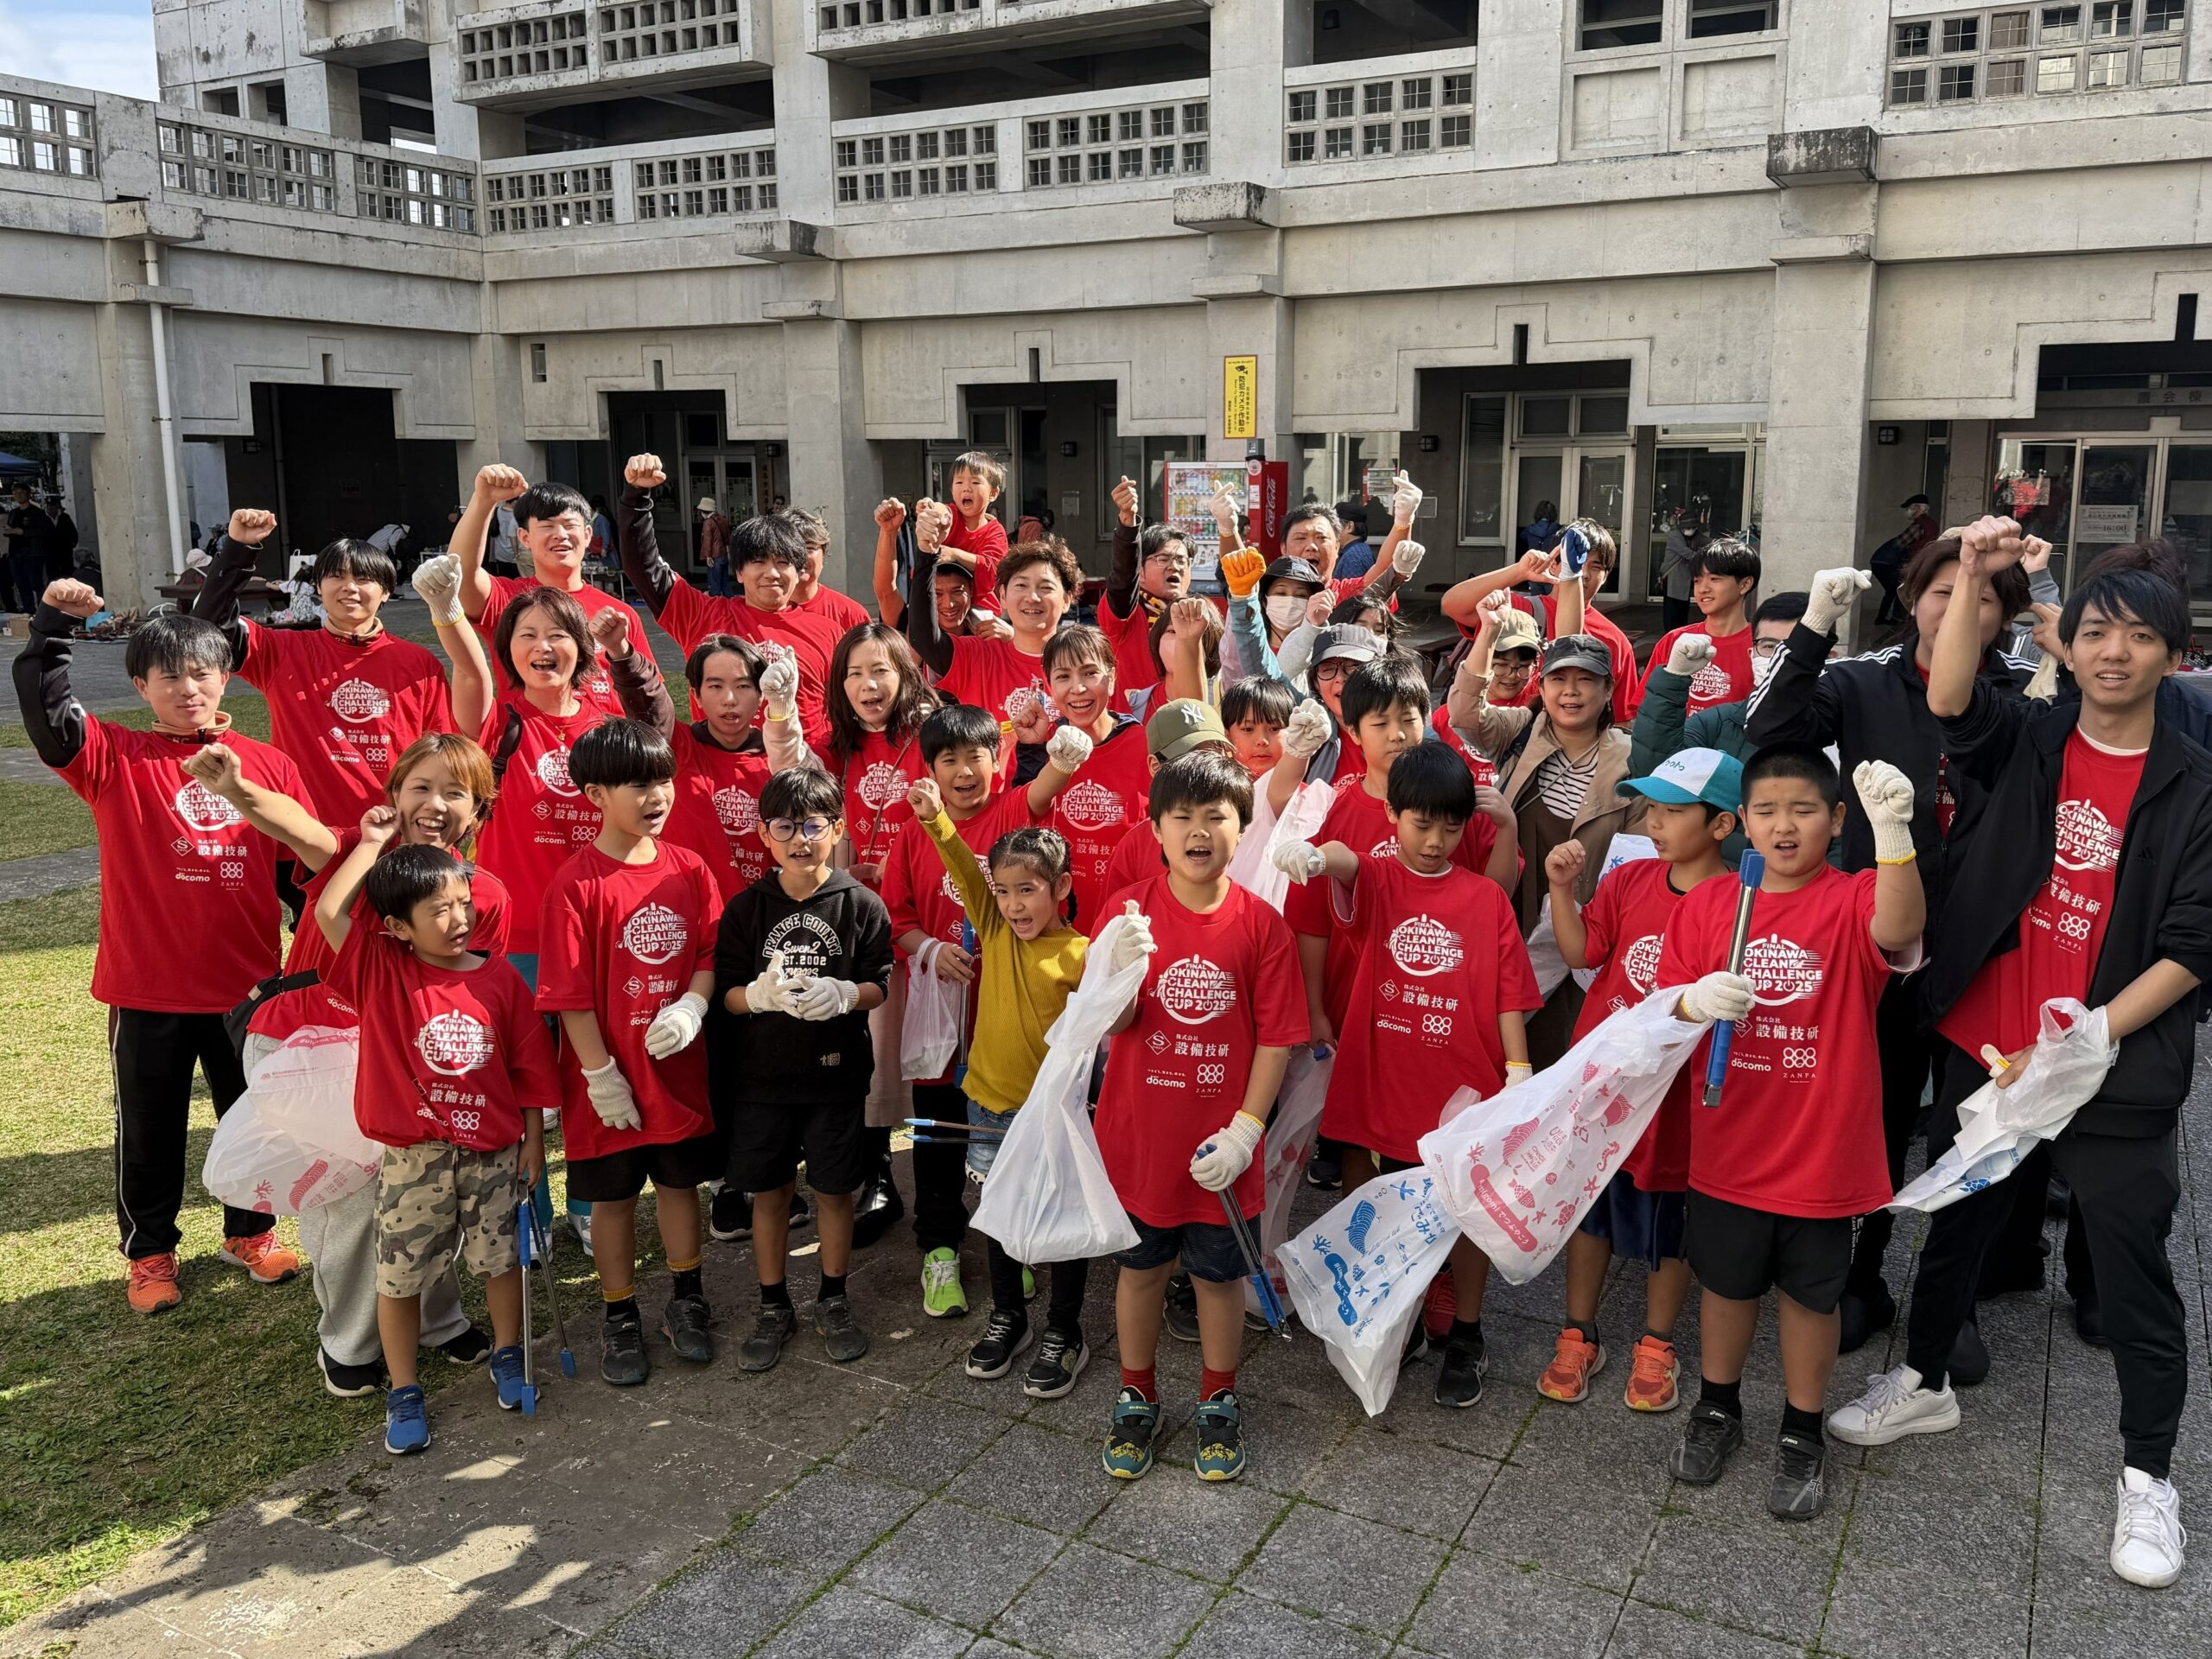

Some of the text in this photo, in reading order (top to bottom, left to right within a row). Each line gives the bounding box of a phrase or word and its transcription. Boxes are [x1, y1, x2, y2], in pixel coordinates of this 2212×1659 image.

[1694, 679, 1732, 691] HALLENGE
[1705, 687, 1725, 696] 2025
[1180, 703, 1206, 724] NY
[330, 754, 360, 764] docomo
[715, 793, 756, 804] OKINAWA
[1070, 789, 1114, 798] OKINAWA
[715, 801, 744, 812] CLEAN
[1068, 804, 1124, 814] CHALLENGE
[2074, 805, 2094, 818] FINAL
[186, 811, 241, 821] CUP 2025
[554, 809, 602, 823] 設備技研
[721, 817, 733, 825] UP
[1066, 811, 1117, 822] CUP 2025
[2057, 804, 2113, 836] OKINAWA
[2056, 815, 2093, 838] CLEAN
[534, 835, 566, 845] docomo
[197, 844, 247, 857] 設備技研
[1077, 843, 1113, 855] 設備技
[2056, 837, 2108, 868] UP 2025
[175, 872, 211, 883] docomo
[632, 914, 678, 926] OKINAWA
[632, 924, 669, 935] CLEAN
[762, 912, 842, 958] ORANGE COUNTY
[1398, 925, 1452, 939] OKINAWA
[632, 931, 688, 944] CHALLENGE
[1398, 934, 1438, 946] CLEAN
[633, 941, 682, 955] CUP 2025
[1397, 944, 1464, 959] CHALLENGE
[1636, 941, 1662, 956] OKIN
[1744, 948, 1808, 959] OKINAWA
[784, 956, 827, 966] ST.2002
[1395, 951, 1455, 968] CUP 2025
[1743, 957, 1788, 969] CLEAN
[1168, 967, 1227, 981] OKINAWA
[1743, 968, 1823, 981] CHALLENGE
[1167, 976, 1209, 989] CLEAN
[1754, 979, 1813, 993] UP 2025
[1166, 987, 1236, 1001] CHALLENGE
[1164, 998, 1227, 1012] CUP 2025
[1402, 991, 1459, 1012] 設備技研
[1756, 1015, 1781, 1024] 株式会社
[429, 1021, 485, 1034] OKINAWA
[1376, 1020, 1412, 1034] docomo
[1756, 1024, 1819, 1041] 設備技研
[428, 1031, 469, 1043] CLEAN
[425, 1040, 495, 1053] CHALLENGE
[1174, 1041, 1230, 1058] 設備技研
[423, 1050, 486, 1064] CUP 2025
[1731, 1058, 1771, 1072] docomo
[1146, 1076, 1186, 1089] docomo
[430, 1089, 486, 1107] 設備技研
